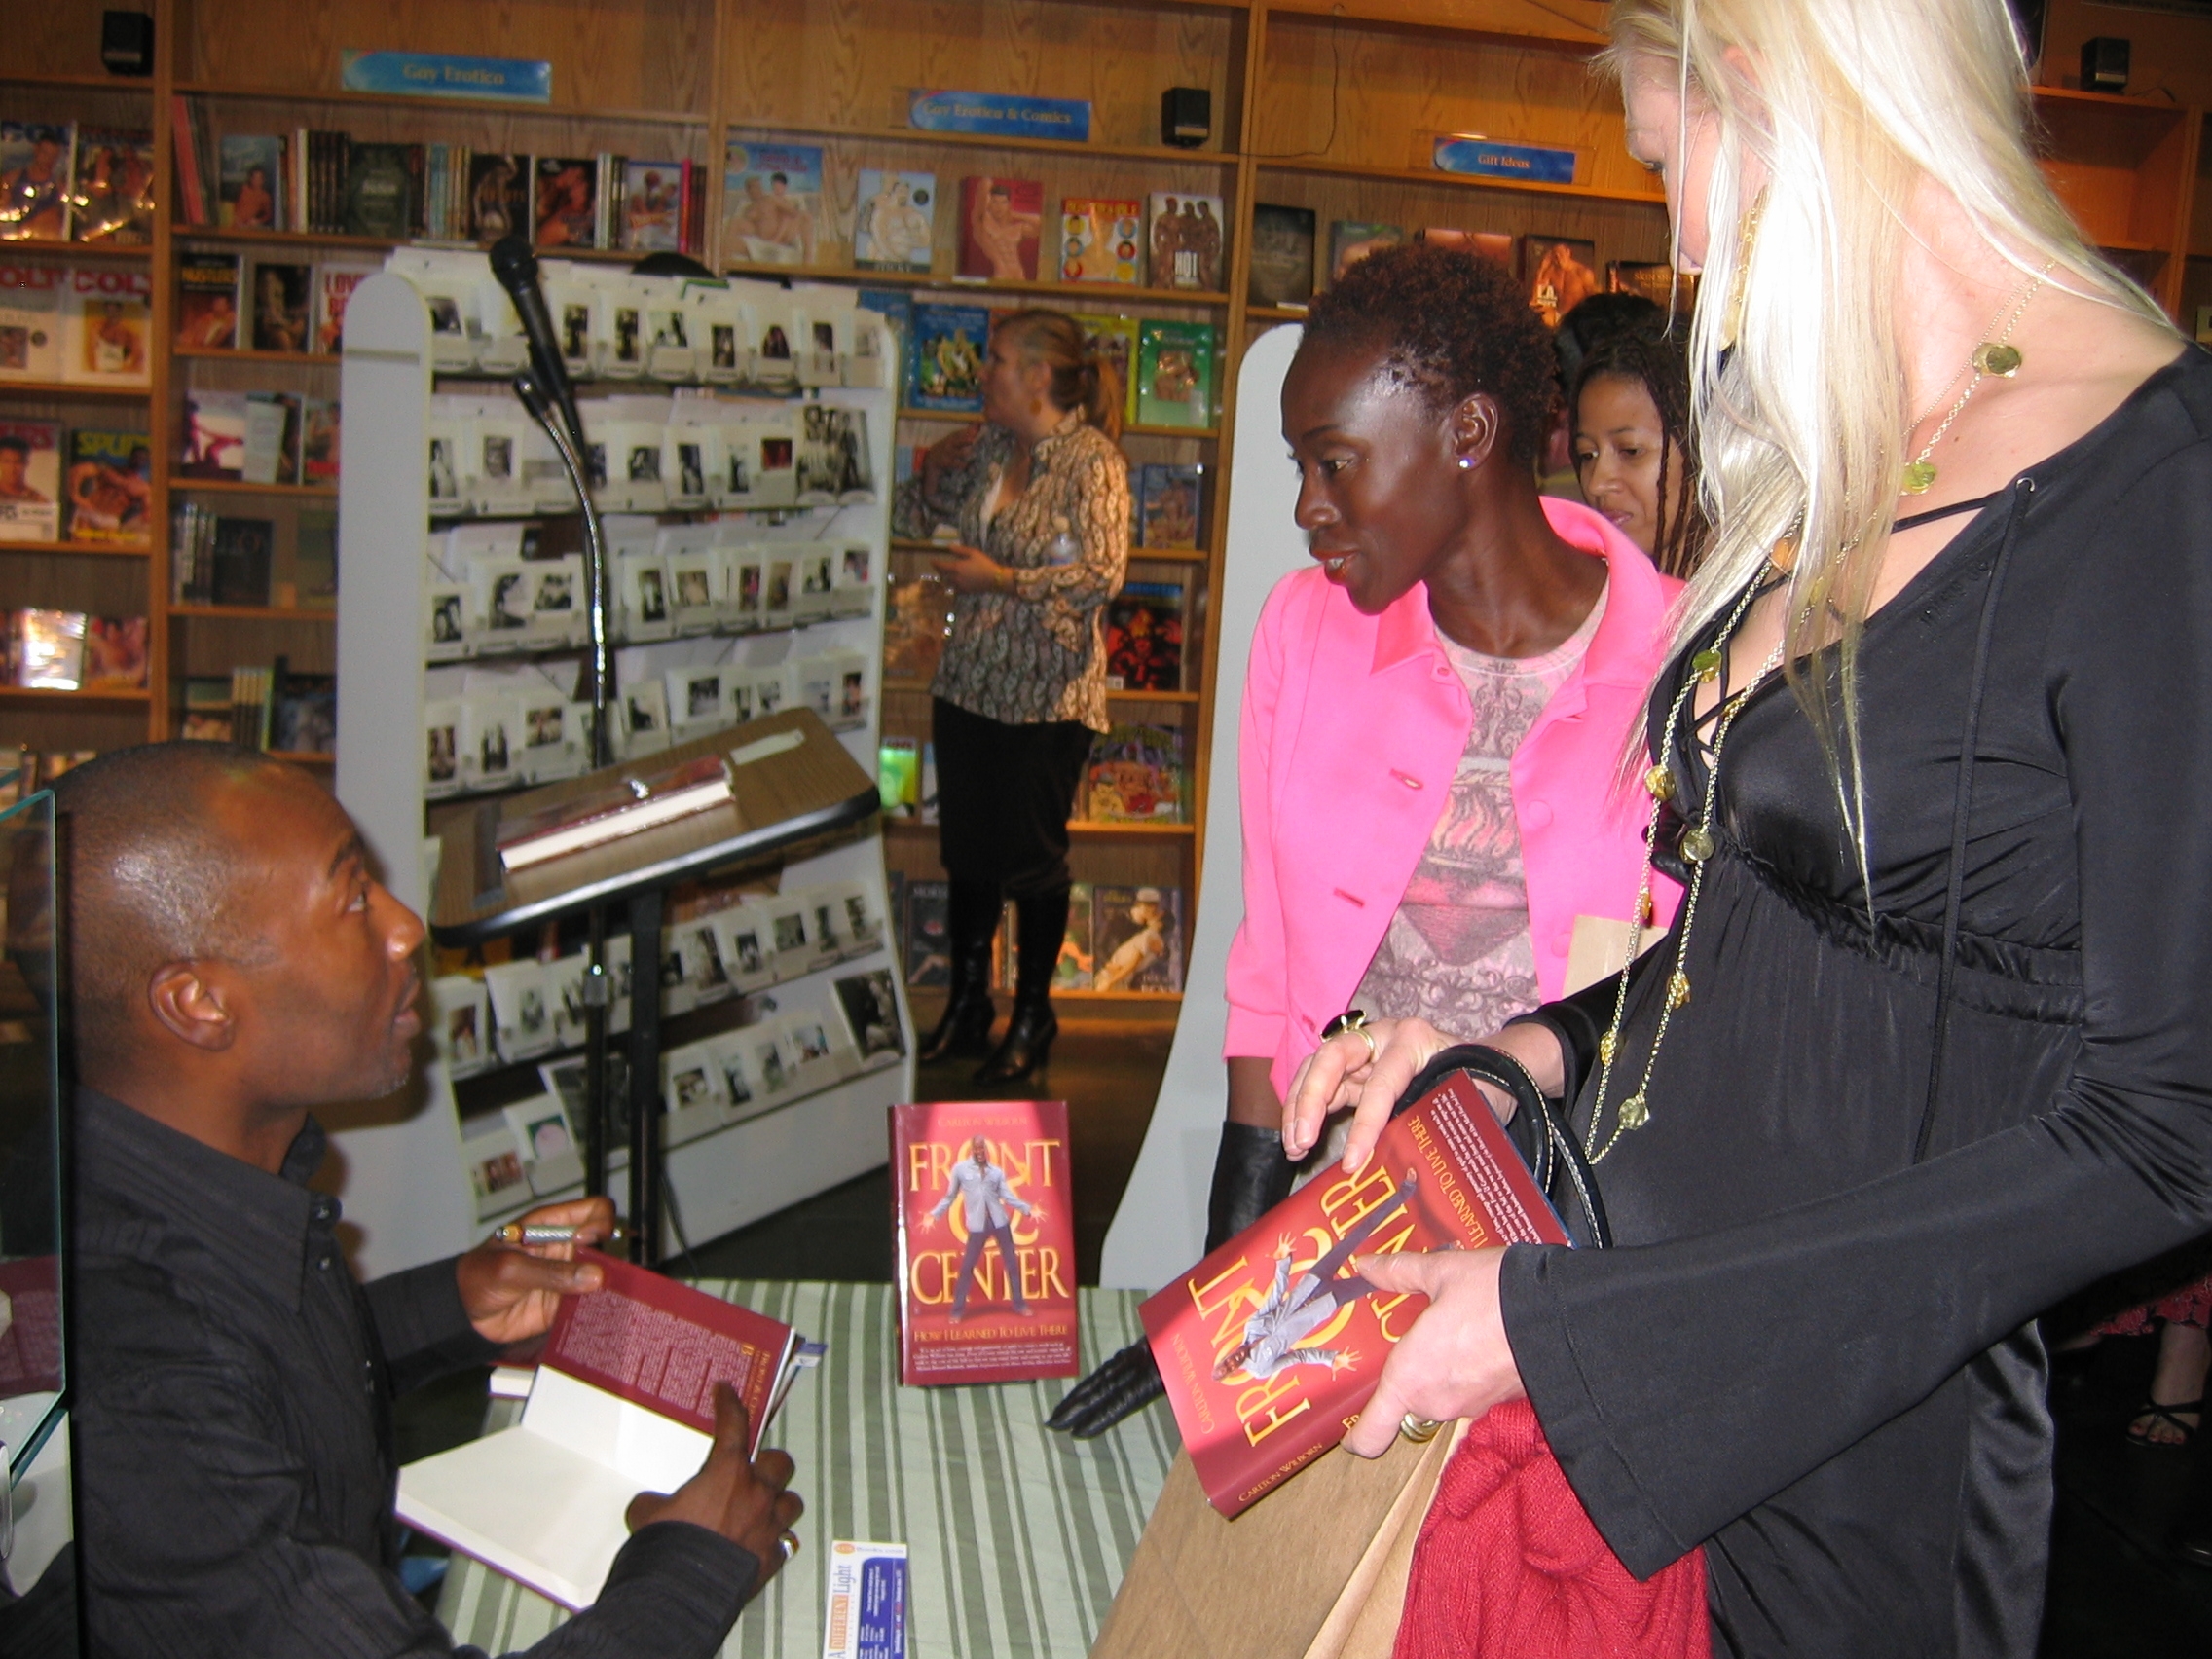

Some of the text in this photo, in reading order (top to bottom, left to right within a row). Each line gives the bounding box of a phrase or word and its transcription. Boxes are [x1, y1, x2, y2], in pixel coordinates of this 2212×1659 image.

[402, 63, 505, 86] Gay Erotica
[954, 104, 1004, 119] Erotica
[1007, 107, 1017, 120] &
[1021, 109, 1072, 124] Comics
[1478, 154, 1531, 168] Gift Ideas
[1403, 1114, 1435, 1153] THERE
[908, 1138, 1060, 1192] FRONT
[1421, 1146, 1448, 1175] LIVE
[1434, 1170, 1458, 1194] TO
[1443, 1186, 1487, 1242] LEARNED
[911, 1247, 1070, 1305] CENTER
[913, 1330, 942, 1342] HOW
[950, 1328, 995, 1341] LEARNED
[999, 1327, 1014, 1339] TO
[1014, 1326, 1036, 1338] LIVE
[1040, 1324, 1069, 1337] THERE
[1187, 1255, 1311, 1447] FRONT
[1168, 1332, 1216, 1435] CARLTON WILBORN
[1237, 1441, 1323, 1502] CARLTON WILBORN
[832, 1564, 857, 1594] Light
